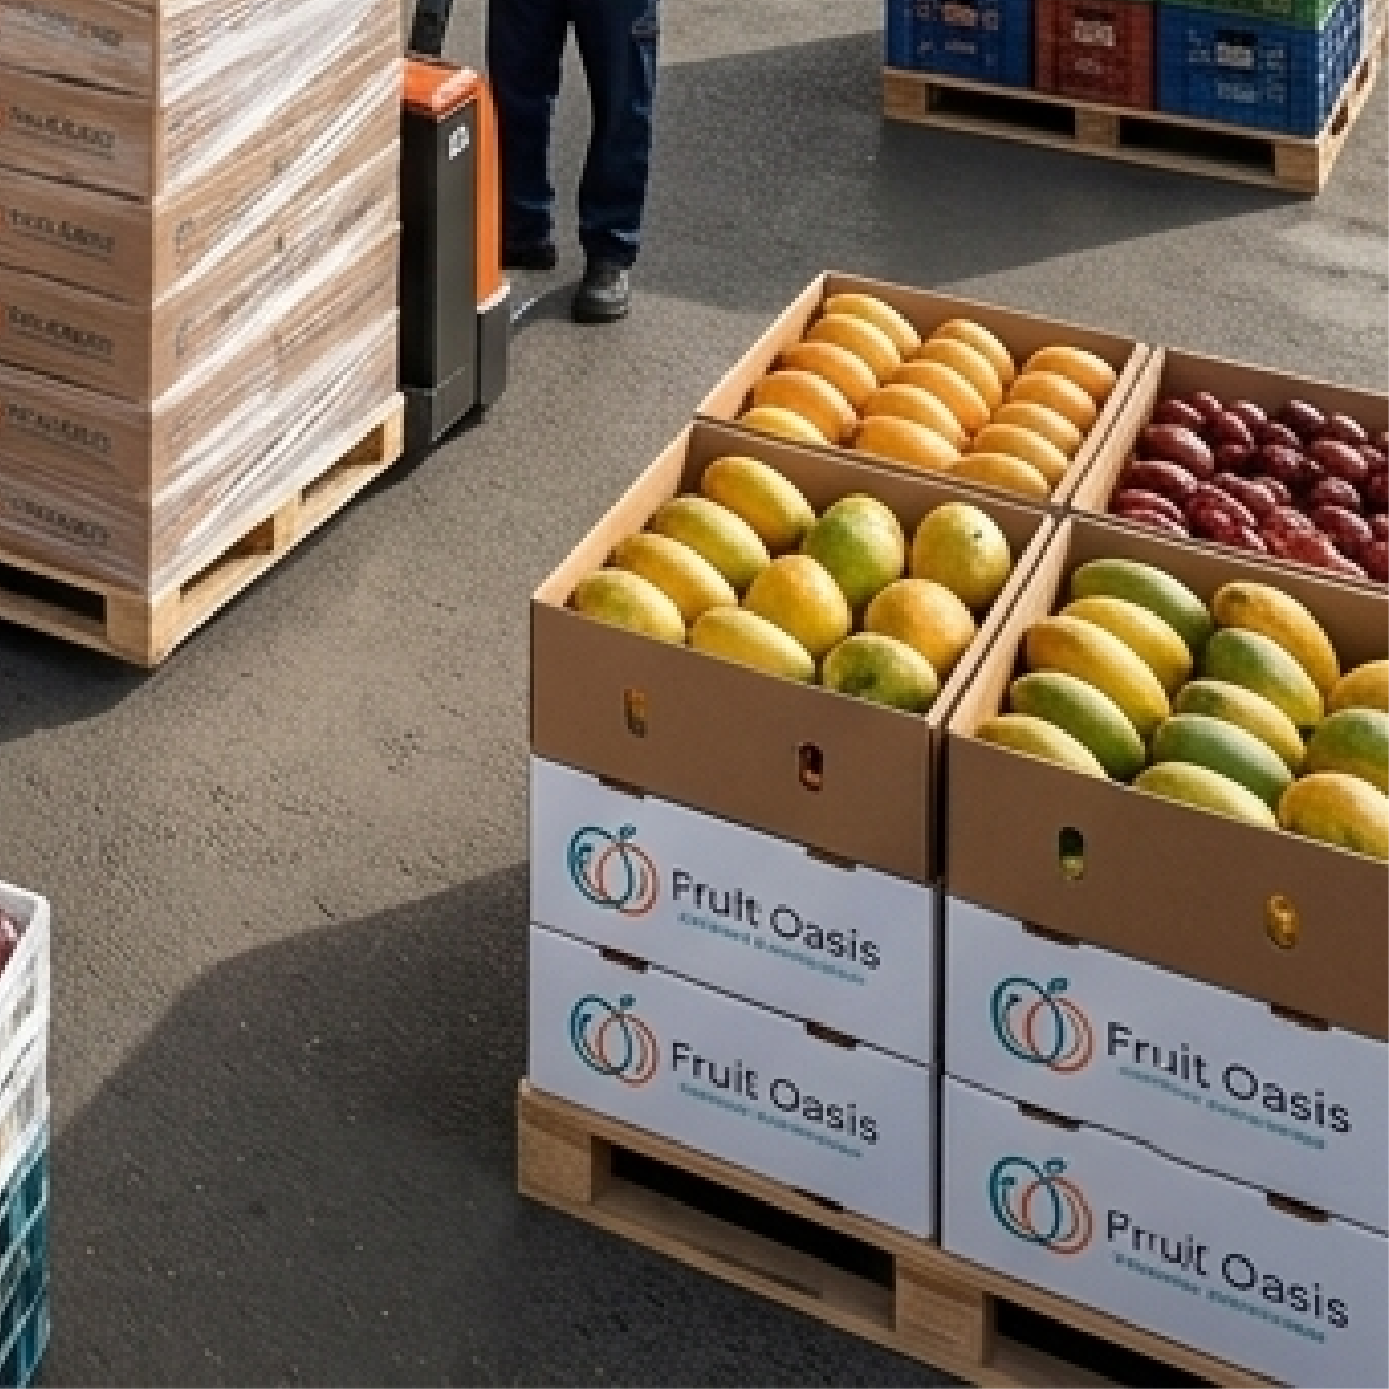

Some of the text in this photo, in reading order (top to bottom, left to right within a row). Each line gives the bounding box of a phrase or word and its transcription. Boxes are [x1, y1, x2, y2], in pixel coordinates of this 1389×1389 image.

[770, 906, 881, 970] Oasis
[672, 1041, 760, 1101] Fruit
[770, 1078, 879, 1147] Oasis
[1107, 1022, 1210, 1089] Fruit
[1223, 1064, 1351, 1134] Oasis
[1222, 1252, 1349, 1329] Oasis
